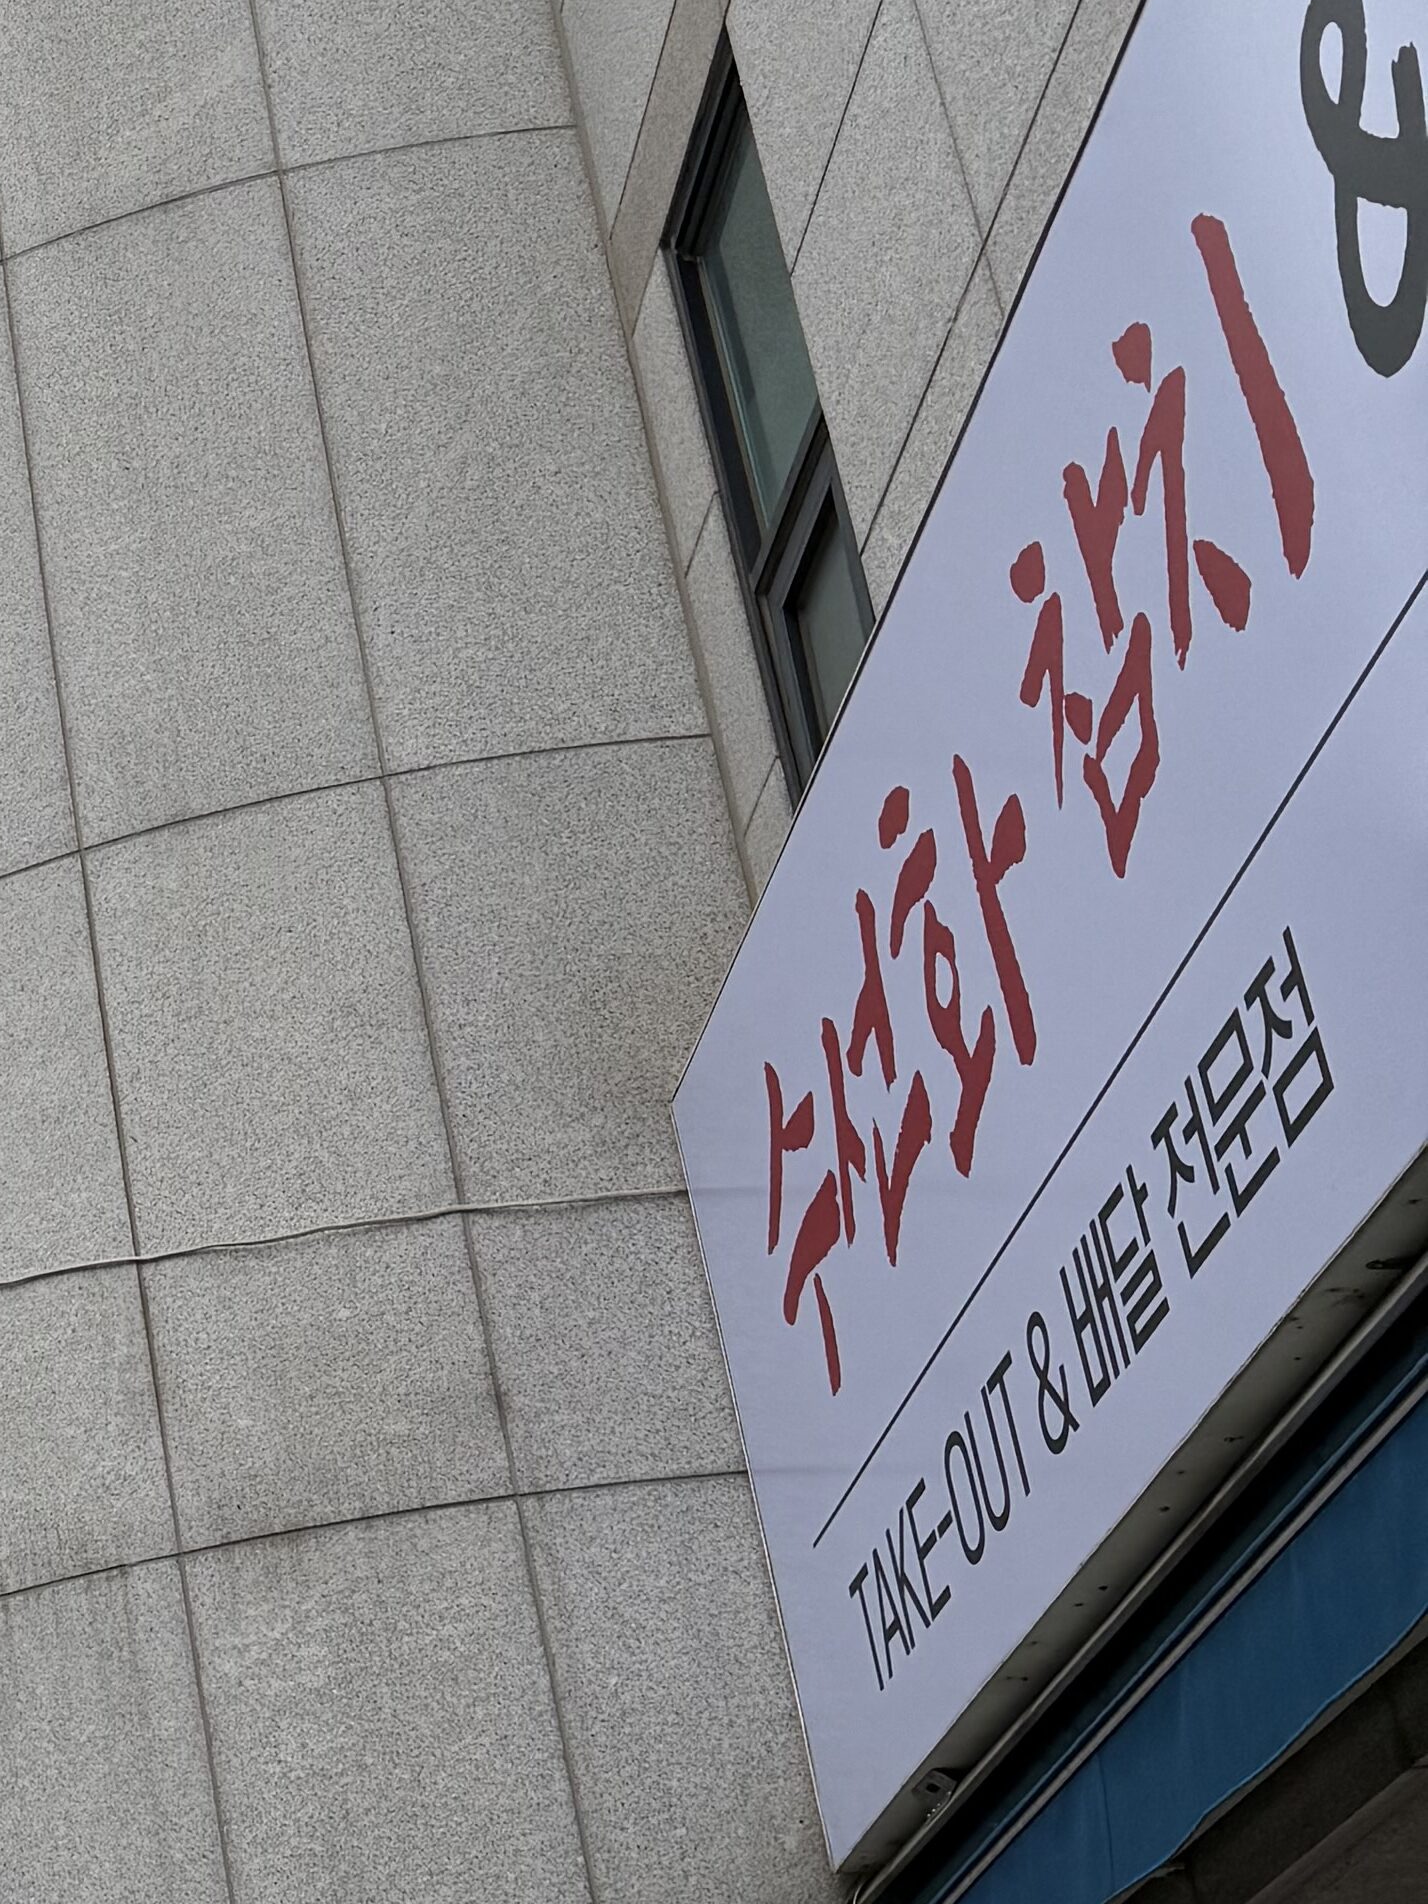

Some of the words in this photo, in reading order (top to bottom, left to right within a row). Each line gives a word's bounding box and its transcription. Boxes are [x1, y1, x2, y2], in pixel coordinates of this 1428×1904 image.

[764, 753, 1037, 1397] 수선화
[1009, 212, 1315, 879] 참치
[848, 1350, 1032, 1692] TAKE-OUT
[1024, 1310, 1080, 1456] &
[1059, 1165, 1170, 1407] 배달
[1151, 926, 1336, 1280] 전문점
